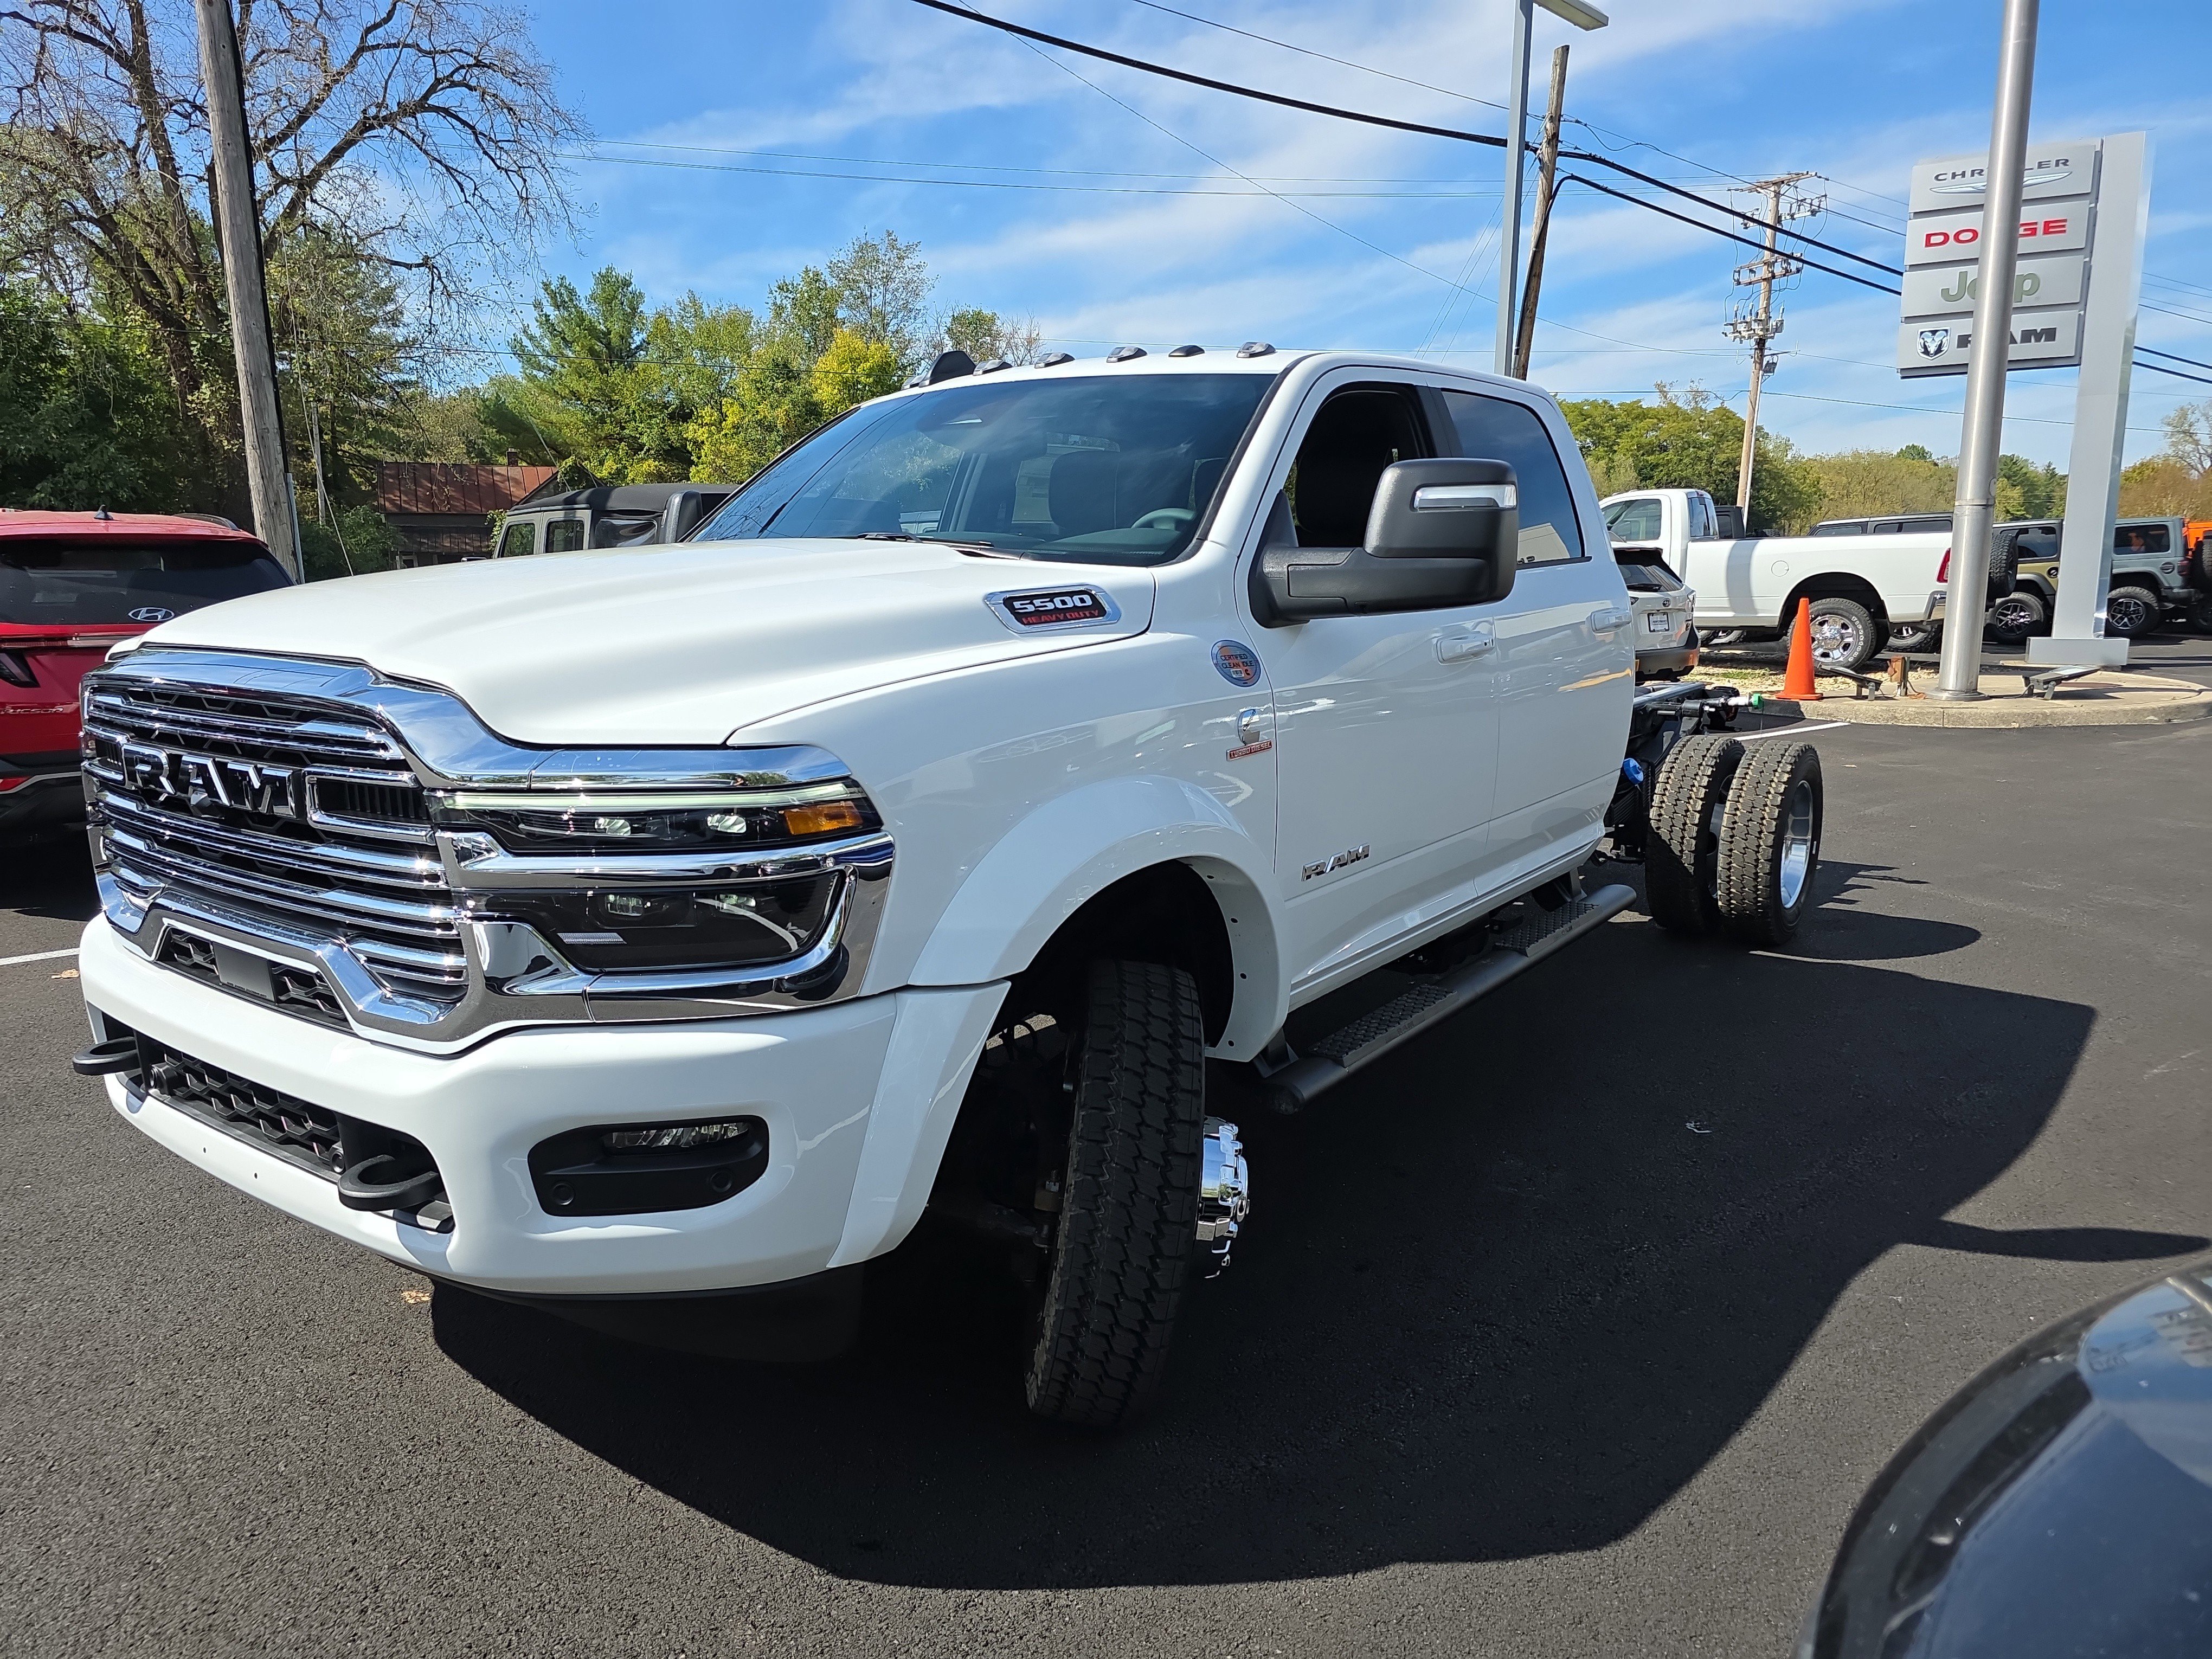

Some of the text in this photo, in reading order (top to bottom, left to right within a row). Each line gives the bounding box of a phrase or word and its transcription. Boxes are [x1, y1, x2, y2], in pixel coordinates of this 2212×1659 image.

[1933, 158, 2070, 182] CHRER
[1924, 218, 2068, 248] DOGE
[1940, 271, 2041, 303] Jp
[1013, 594, 1092, 613] 5500
[1022, 609, 1099, 624] HEAVY DUTY
[1230, 741, 1271, 758] TURBO DIESEL
[123, 743, 297, 818] RAM
[1301, 843, 1369, 882] RAM
